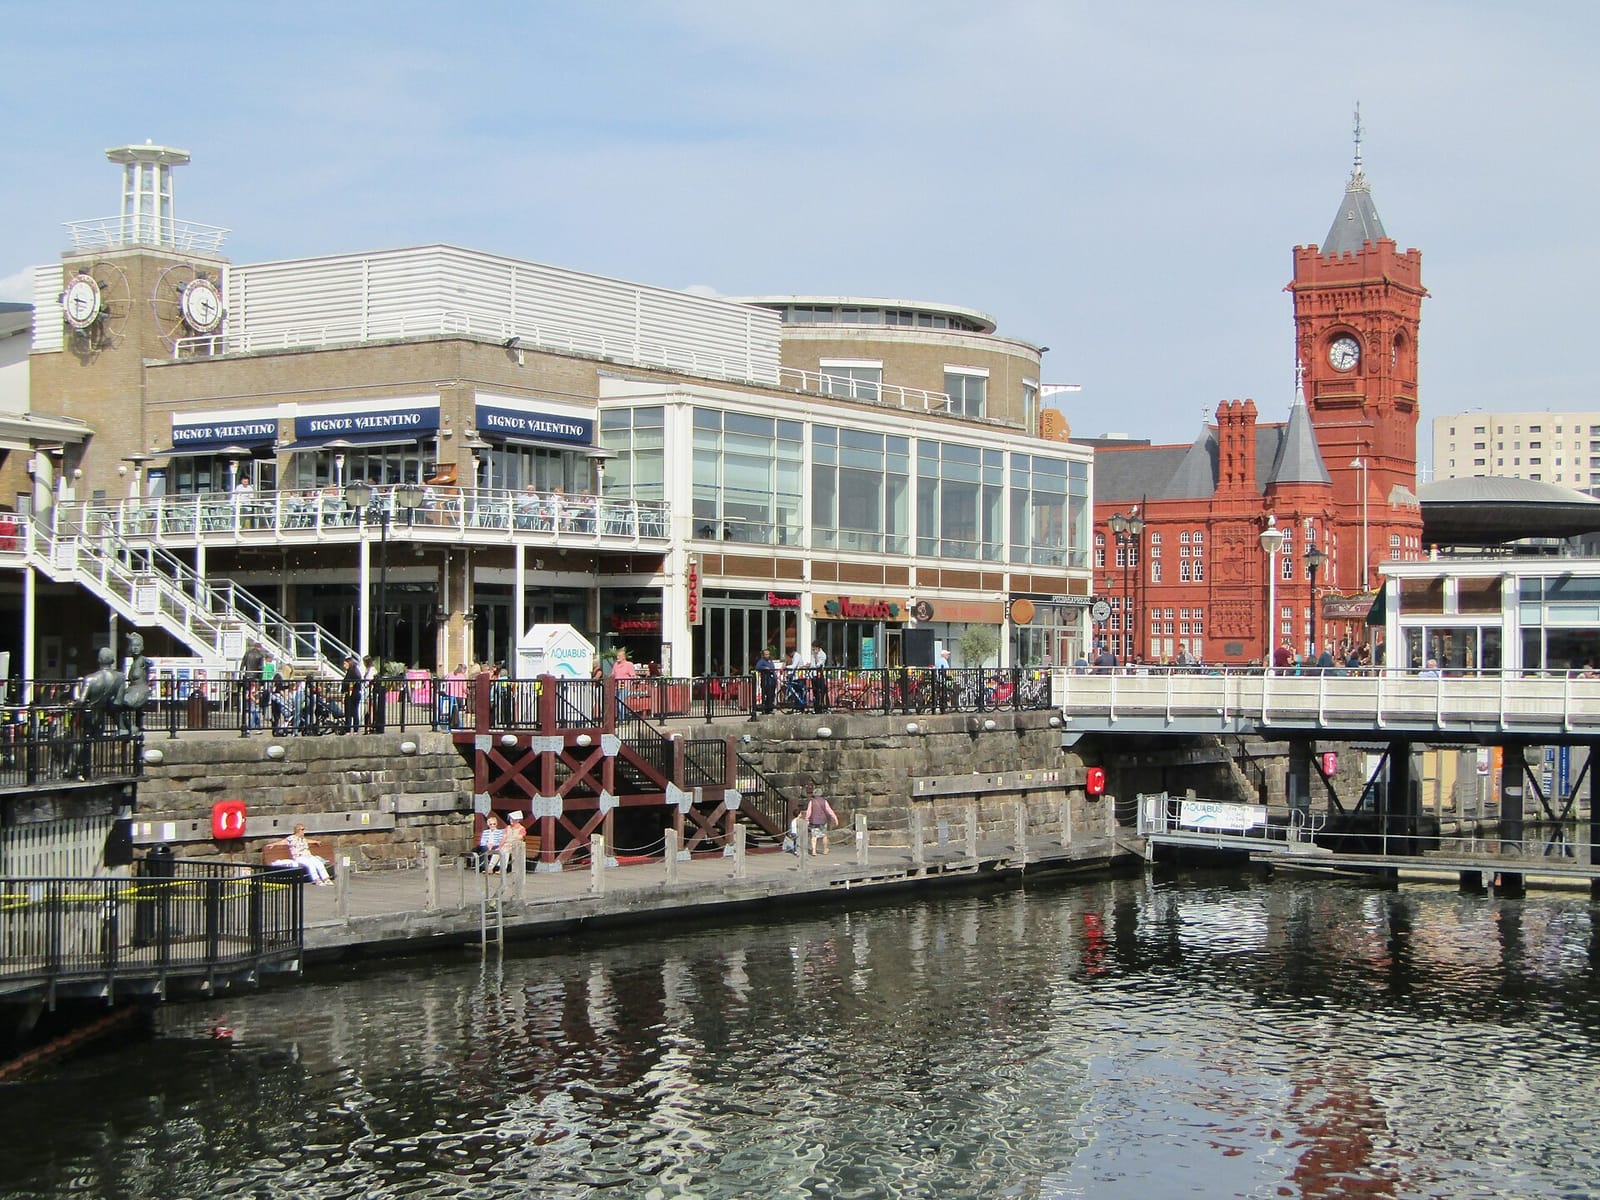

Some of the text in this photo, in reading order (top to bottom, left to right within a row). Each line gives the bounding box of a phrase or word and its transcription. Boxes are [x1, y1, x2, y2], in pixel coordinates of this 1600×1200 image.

[173, 423, 276, 440] SIGNOR VALENTINO
[310, 413, 421, 432] SIGNOR VALENTINO
[487, 414, 584, 436] SIGNOR VALENTINO
[688, 564, 698, 622] IGUANAS
[550, 647, 587, 659] AQUABUS
[1183, 802, 1224, 814] AQUABUS
